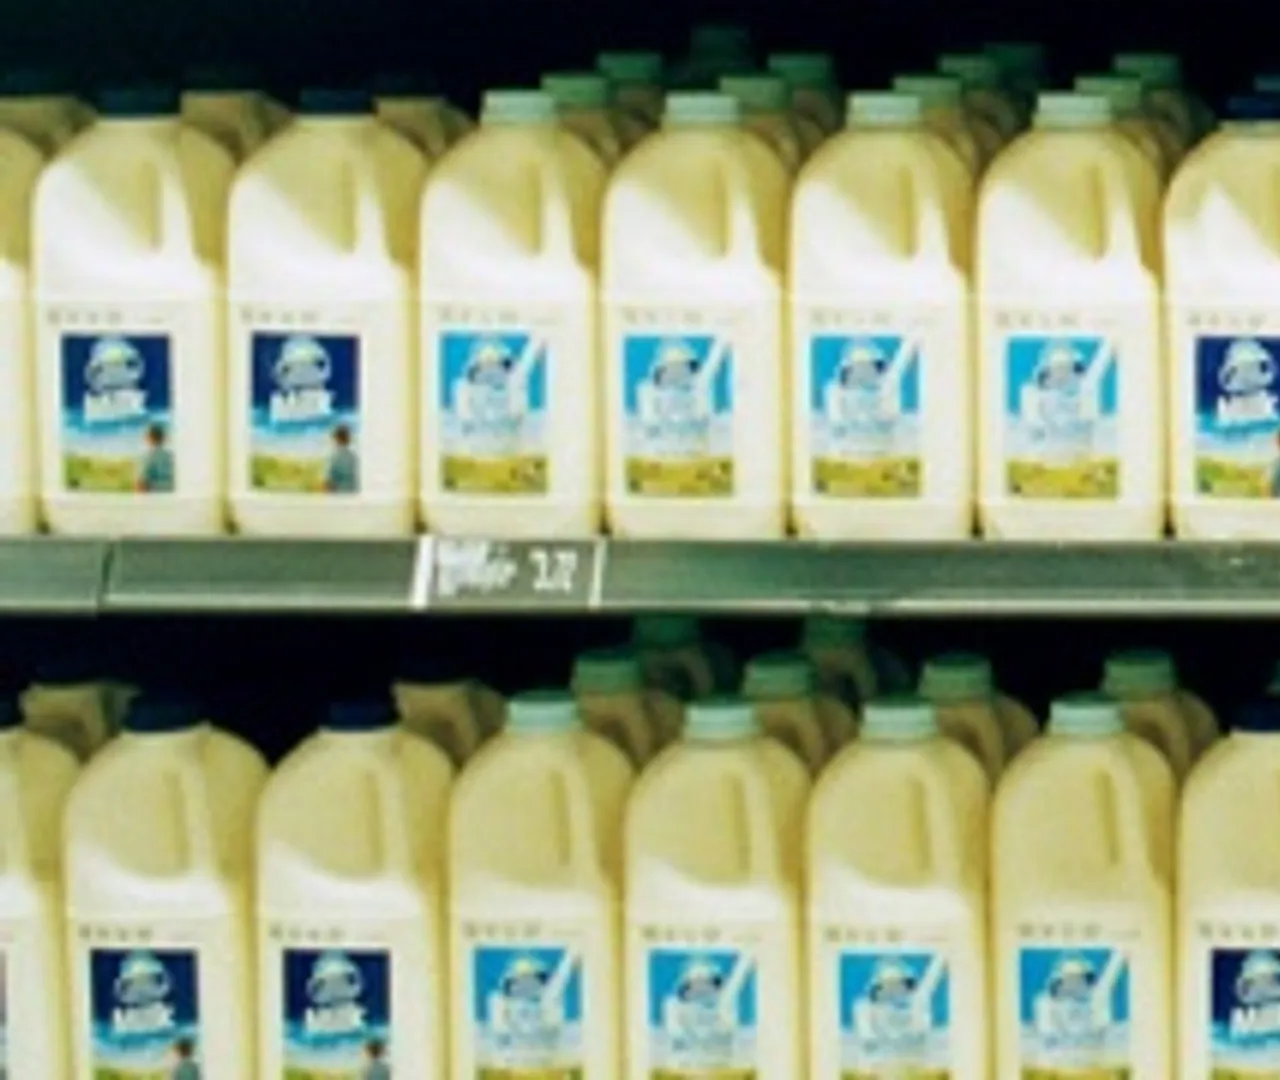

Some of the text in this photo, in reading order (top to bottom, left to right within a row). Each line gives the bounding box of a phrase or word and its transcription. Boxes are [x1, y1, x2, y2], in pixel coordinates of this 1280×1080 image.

[84, 387, 144, 422] Milk
[270, 386, 331, 422] Milk
[1217, 391, 1278, 426] Milk
